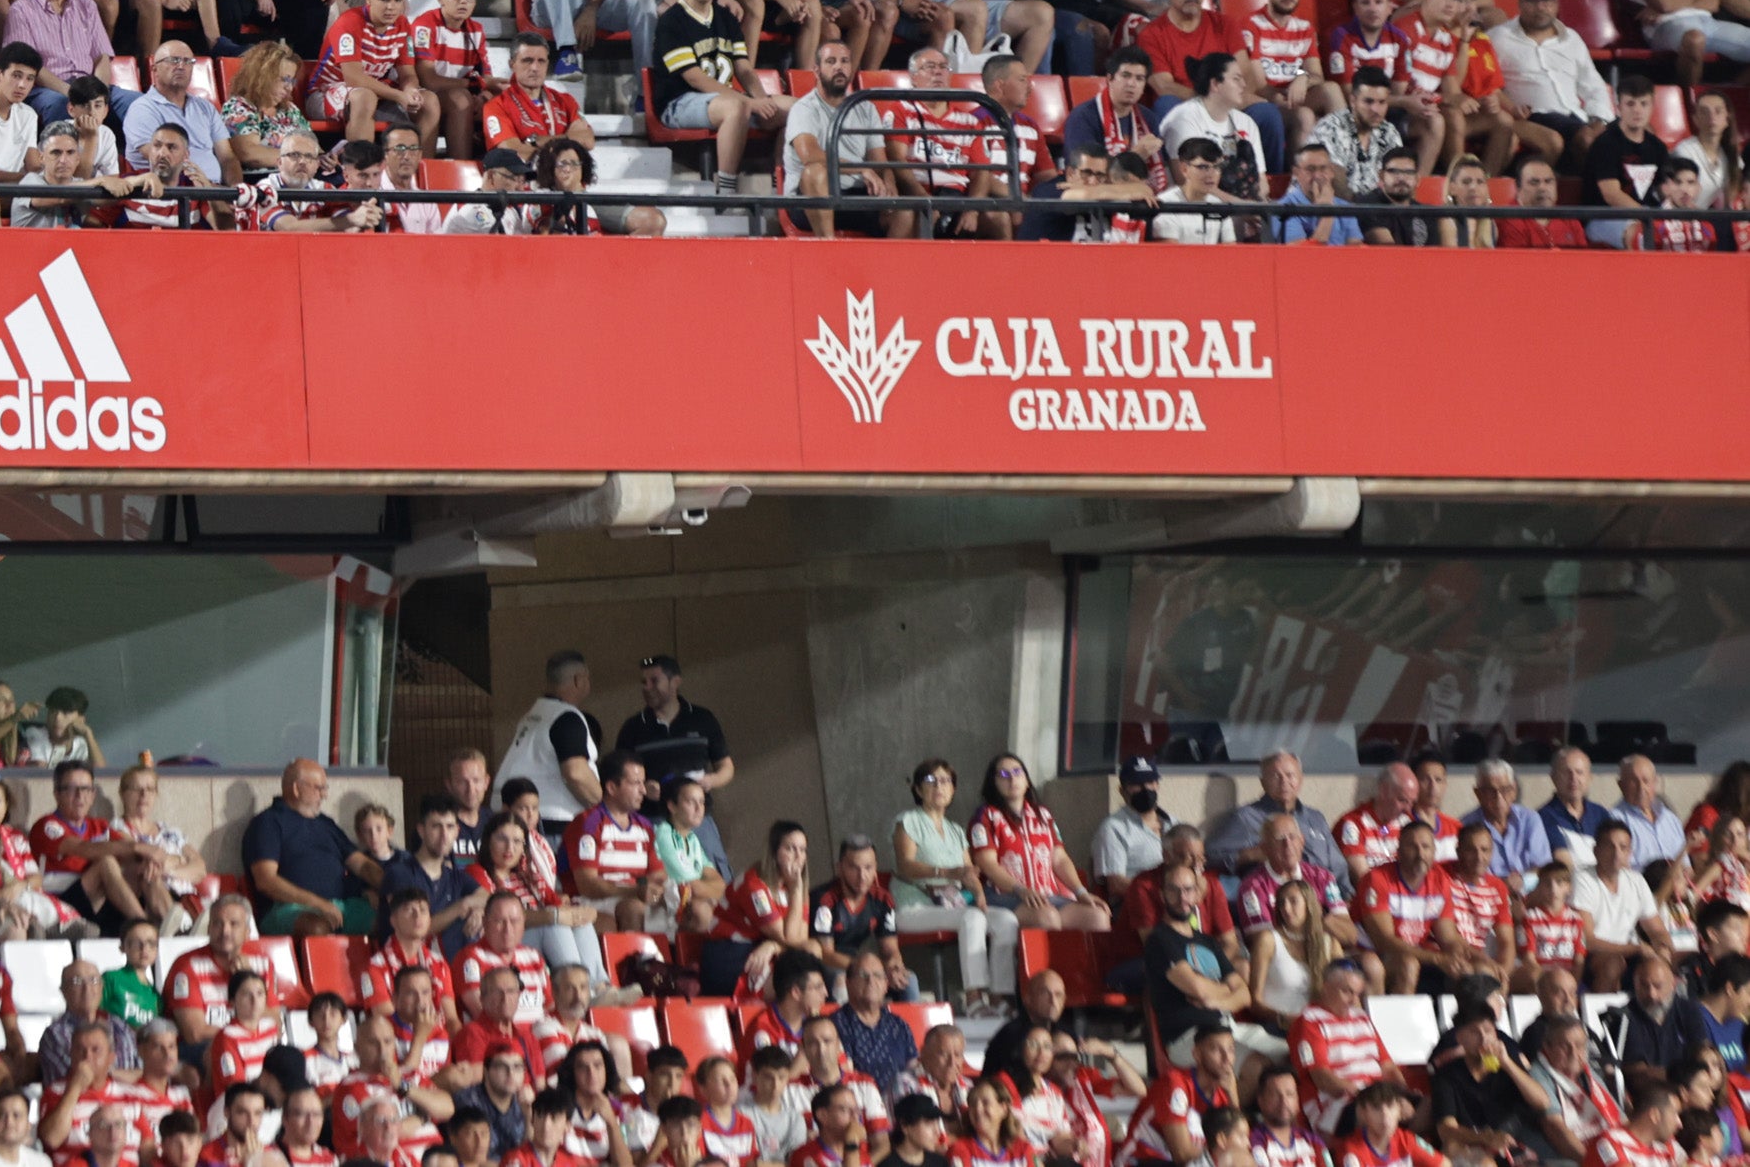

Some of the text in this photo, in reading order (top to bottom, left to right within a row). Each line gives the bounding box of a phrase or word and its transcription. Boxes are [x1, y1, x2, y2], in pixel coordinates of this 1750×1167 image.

[936, 317, 1273, 381] CAJA RURAL
[1008, 388, 1207, 432] GRANADA
